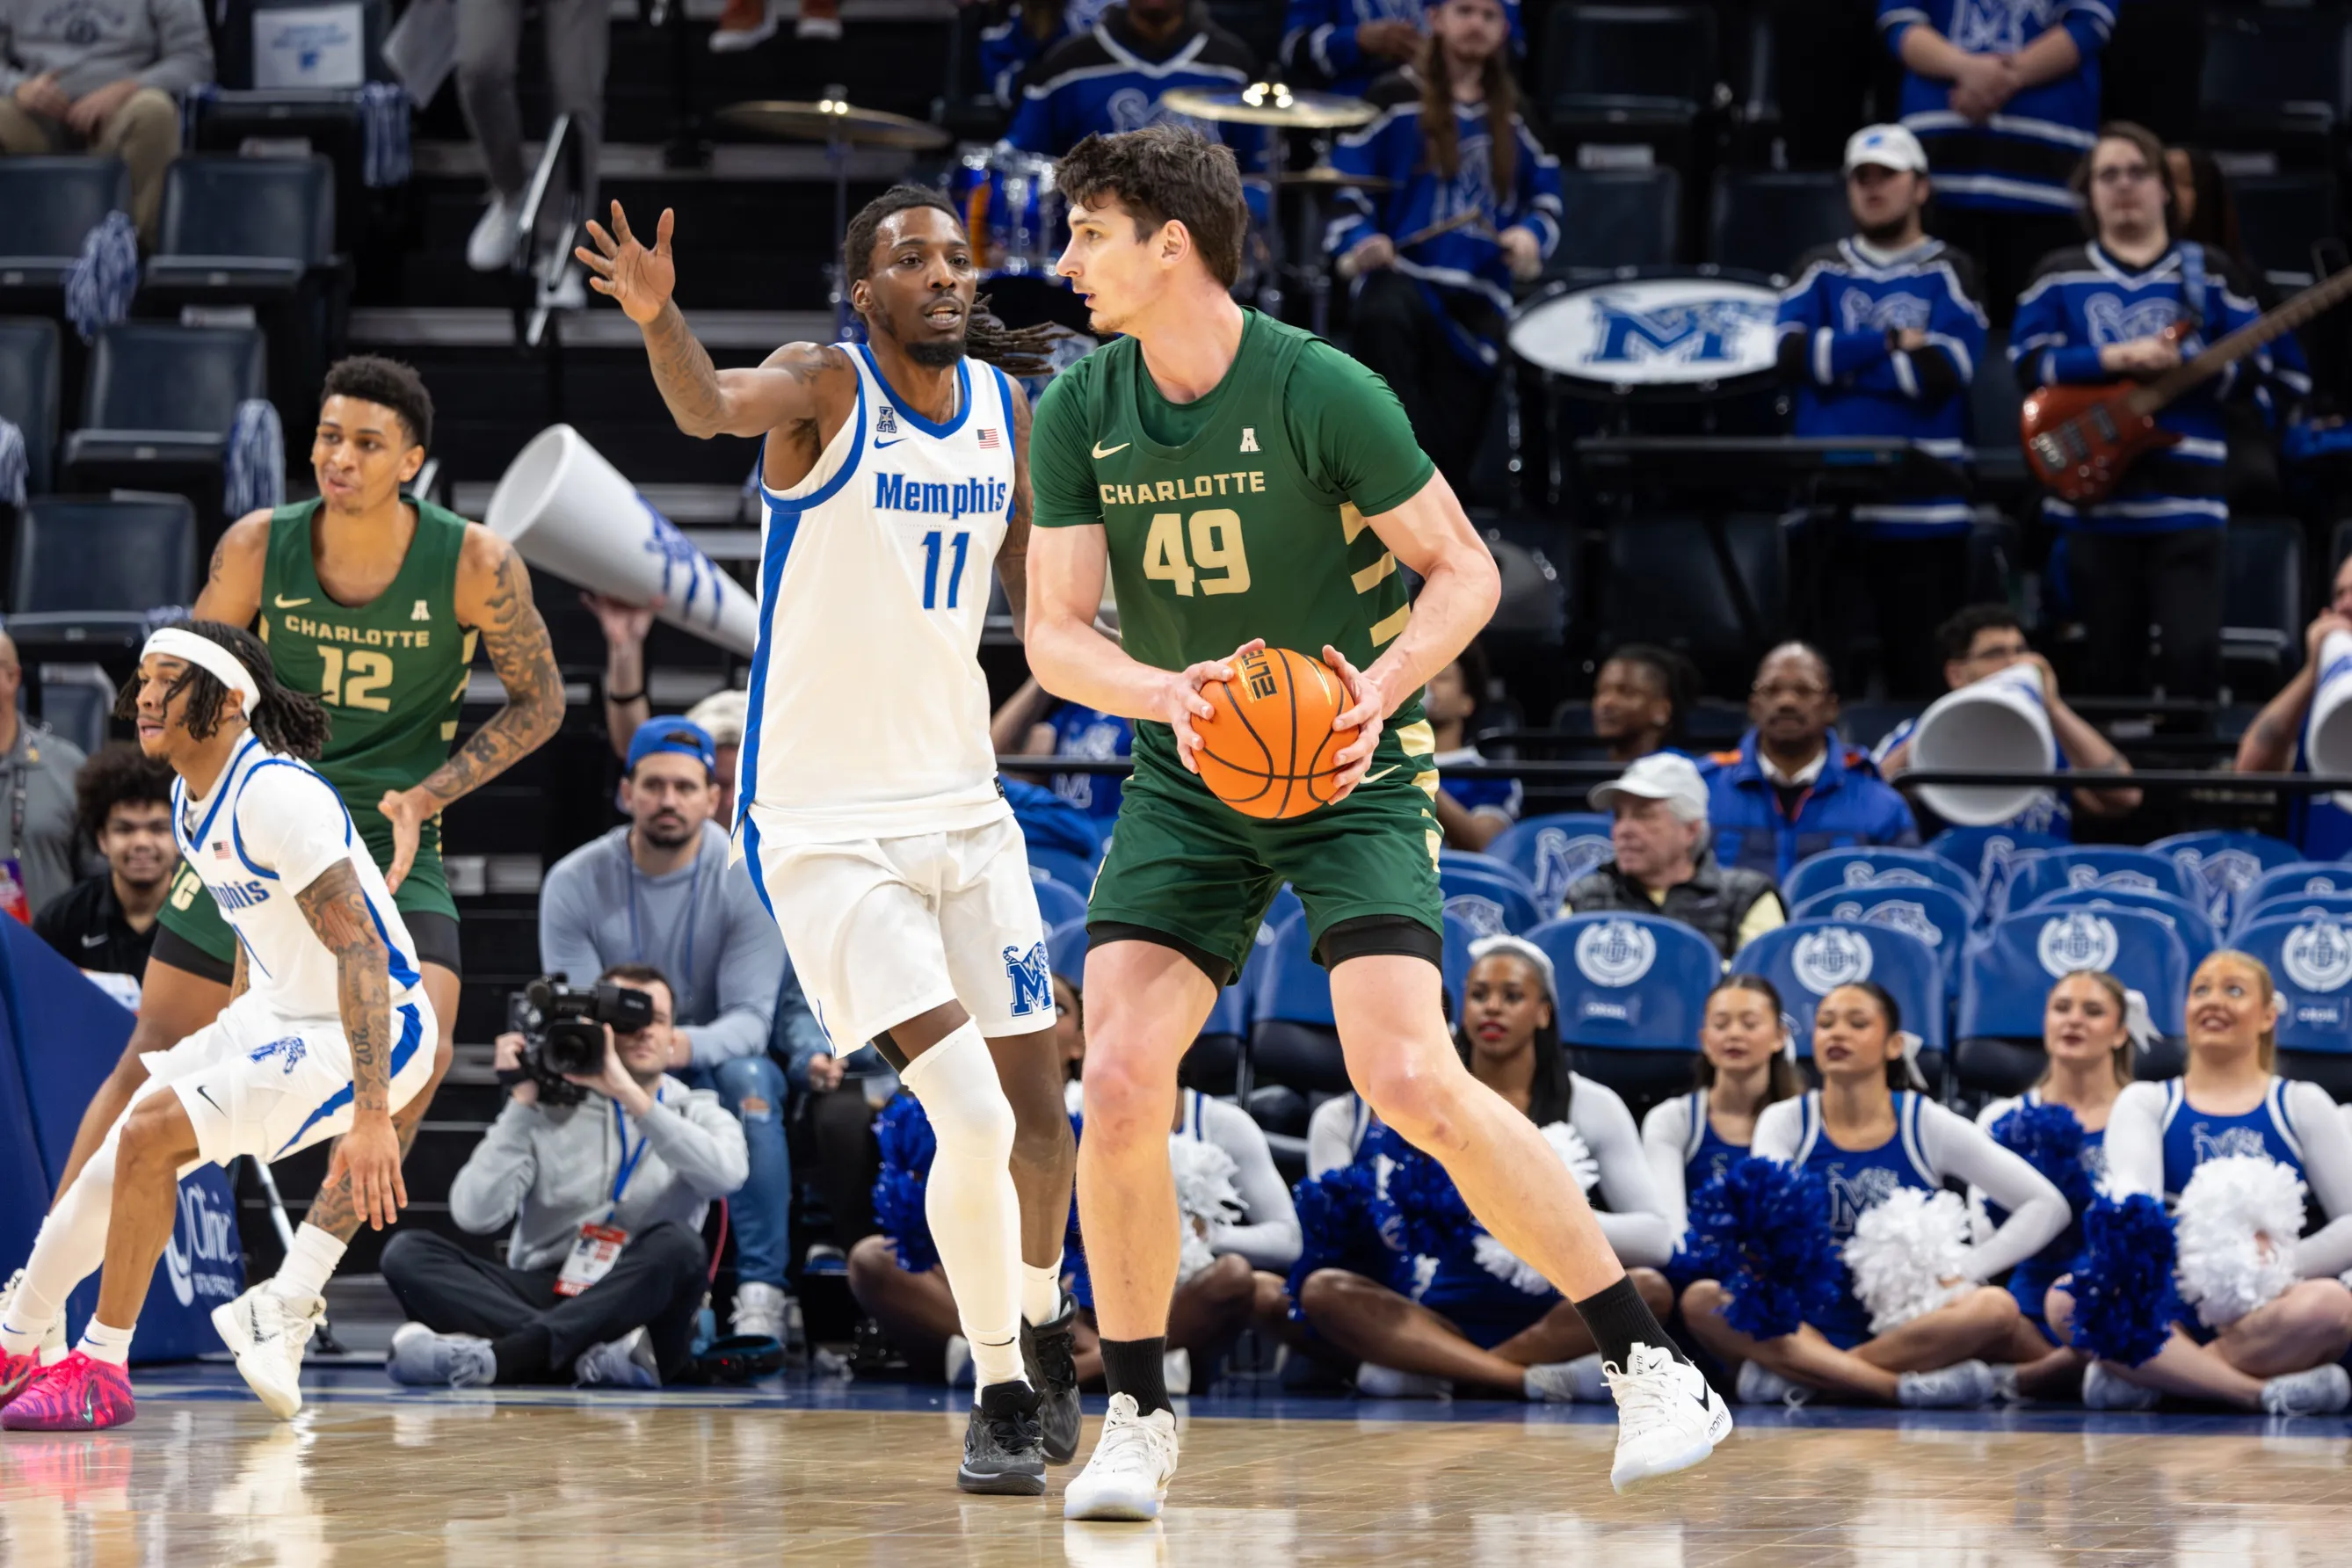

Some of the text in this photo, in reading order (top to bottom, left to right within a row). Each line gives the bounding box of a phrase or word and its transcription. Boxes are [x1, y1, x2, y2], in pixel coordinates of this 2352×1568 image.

[873, 470, 1006, 520] Memphis
[1100, 471, 1267, 505] CHARLOTTE
[920, 530, 971, 610] 11
[1143, 508, 1252, 598] 49
[285, 614, 430, 649] CHARLOTTE
[316, 644, 394, 713] 12
